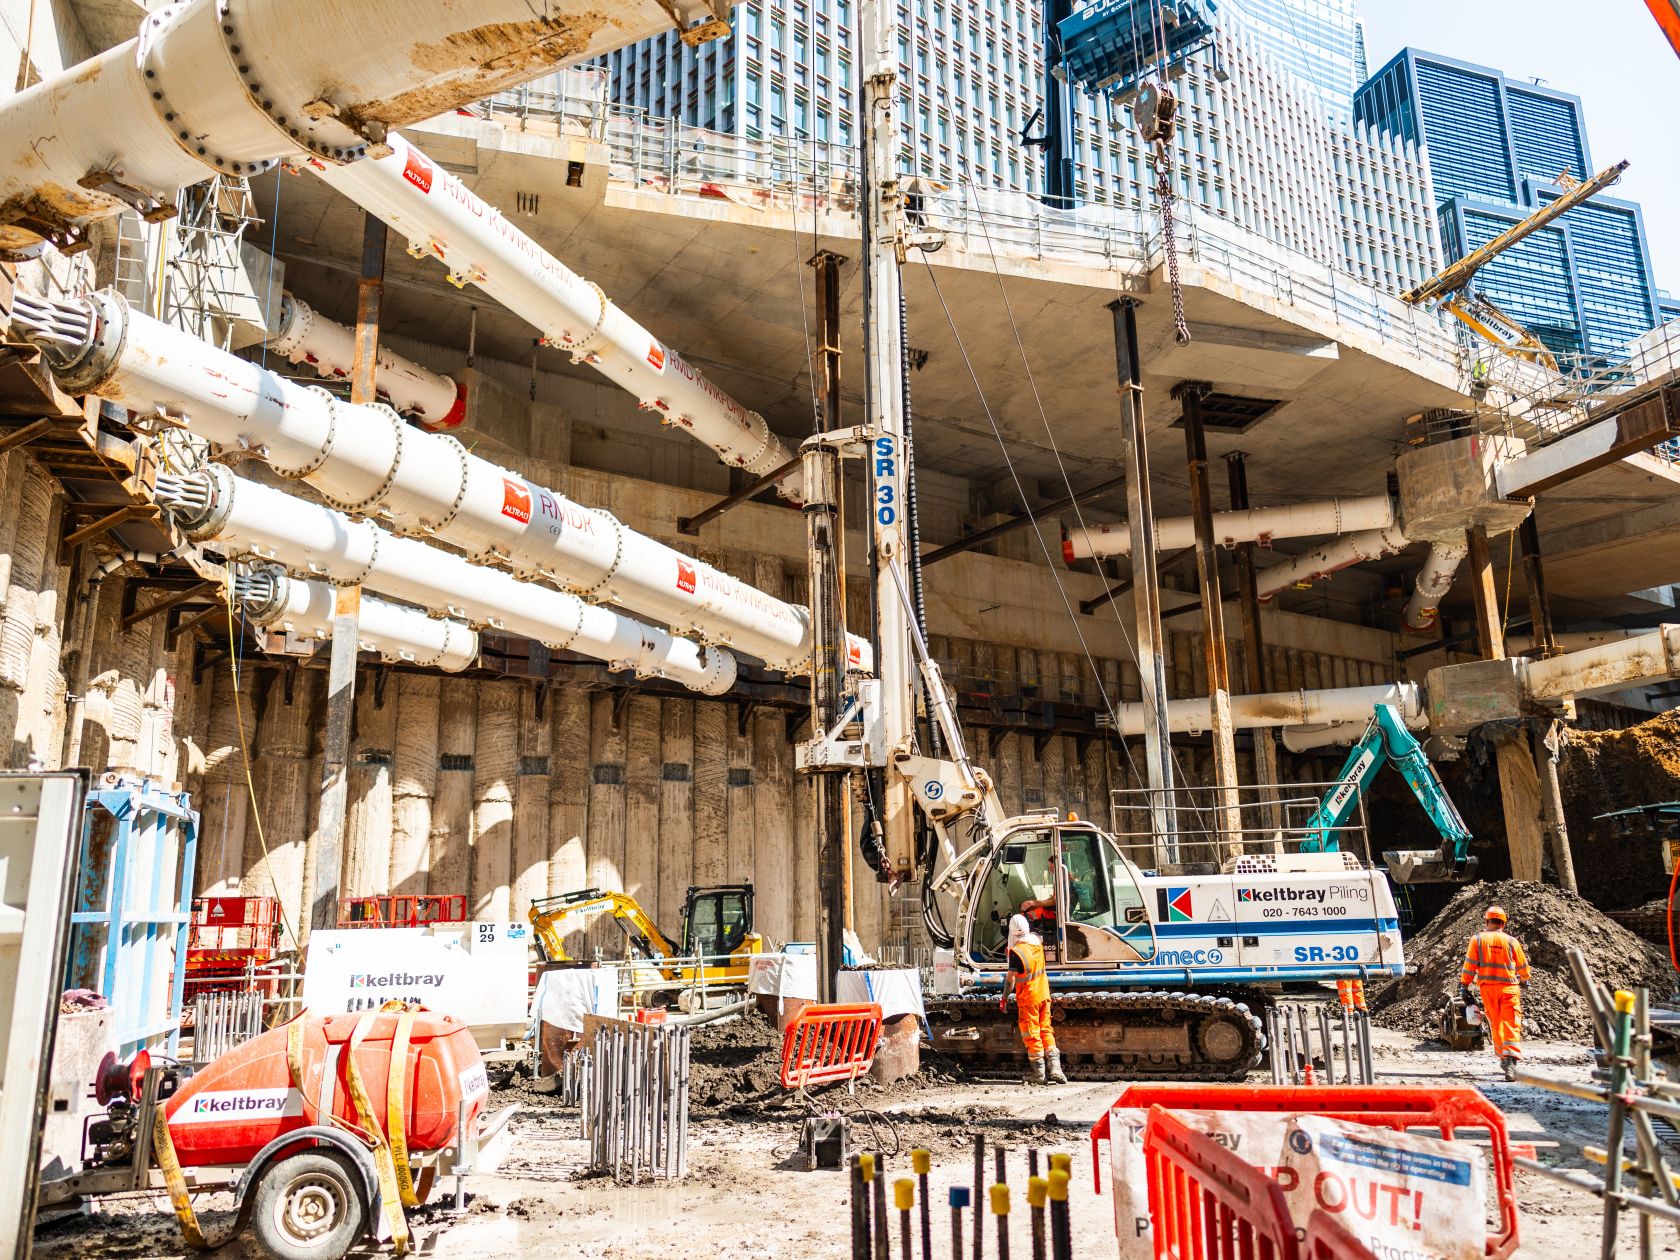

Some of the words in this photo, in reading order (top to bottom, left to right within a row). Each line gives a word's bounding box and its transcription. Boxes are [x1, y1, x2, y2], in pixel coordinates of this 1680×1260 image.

[405, 169, 430, 190] ALTRAD
[443, 173, 483, 218] RMD
[489, 213, 573, 289] KWIKFORM
[1475, 311, 1514, 340] keltbray
[669, 352, 693, 380] RMD
[696, 375, 749, 424] KWIKFORM
[876, 437, 895, 477] SR
[504, 504, 529, 520] ALTRAD
[540, 493, 594, 536] RMDK
[878, 485, 895, 525] 30
[702, 571, 731, 596] RMD
[1253, 888, 1326, 903] keltbray
[1329, 885, 1368, 902] Piling
[1263, 908, 1283, 917] 020
[1292, 907, 1318, 917] 7643
[1322, 906, 1347, 917] 1000
[479, 924, 496, 934] DT
[479, 934, 495, 943] 29
[1294, 945, 1359, 963] SR-30
[366, 972, 445, 988] keltbray
[209, 1096, 288, 1112] keltbray
[395, 1145, 403, 1161] WLL
[399, 1164, 409, 1190] 3000KG
[1356, 1154, 1376, 1164] when
[1377, 1158, 1389, 1168] the
[1410, 1166, 1446, 1179] operating
[1382, 1150, 1400, 1160] must
[1402, 1152, 1412, 1162] be
[1413, 1156, 1432, 1166] worn
[1433, 1159, 1441, 1167] in
[1442, 1160, 1456, 1171] this
[1314, 1171, 1423, 1231] OUT!
